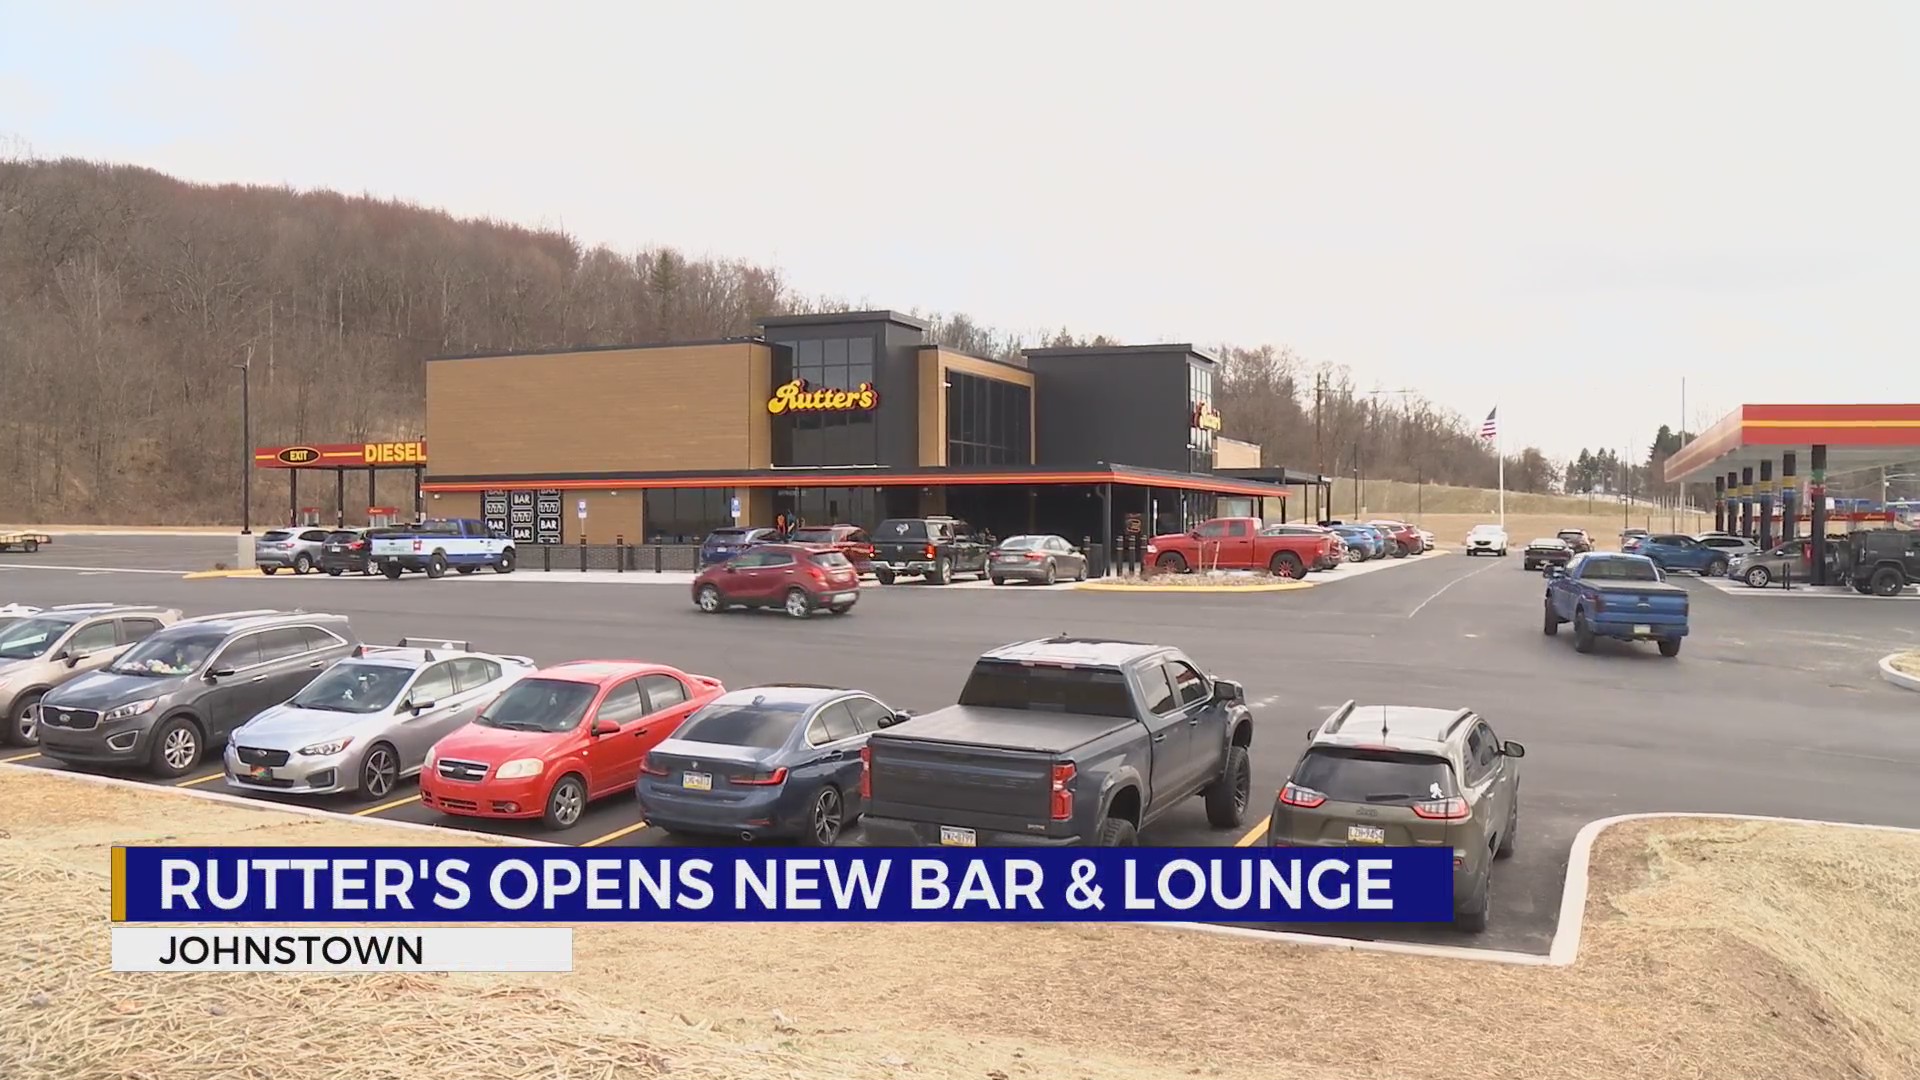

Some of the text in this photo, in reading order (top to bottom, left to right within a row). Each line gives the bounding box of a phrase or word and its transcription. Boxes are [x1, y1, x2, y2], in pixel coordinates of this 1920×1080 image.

[768, 380, 877, 414] Rutter's
[290, 451, 308, 461] EXIT
[365, 443, 426, 462] DIESEL
[514, 494, 531, 504] BAR
[540, 502, 558, 513] 777
[513, 511, 531, 522] 777
[540, 520, 557, 530] BAR
[514, 529, 531, 539] BAR
